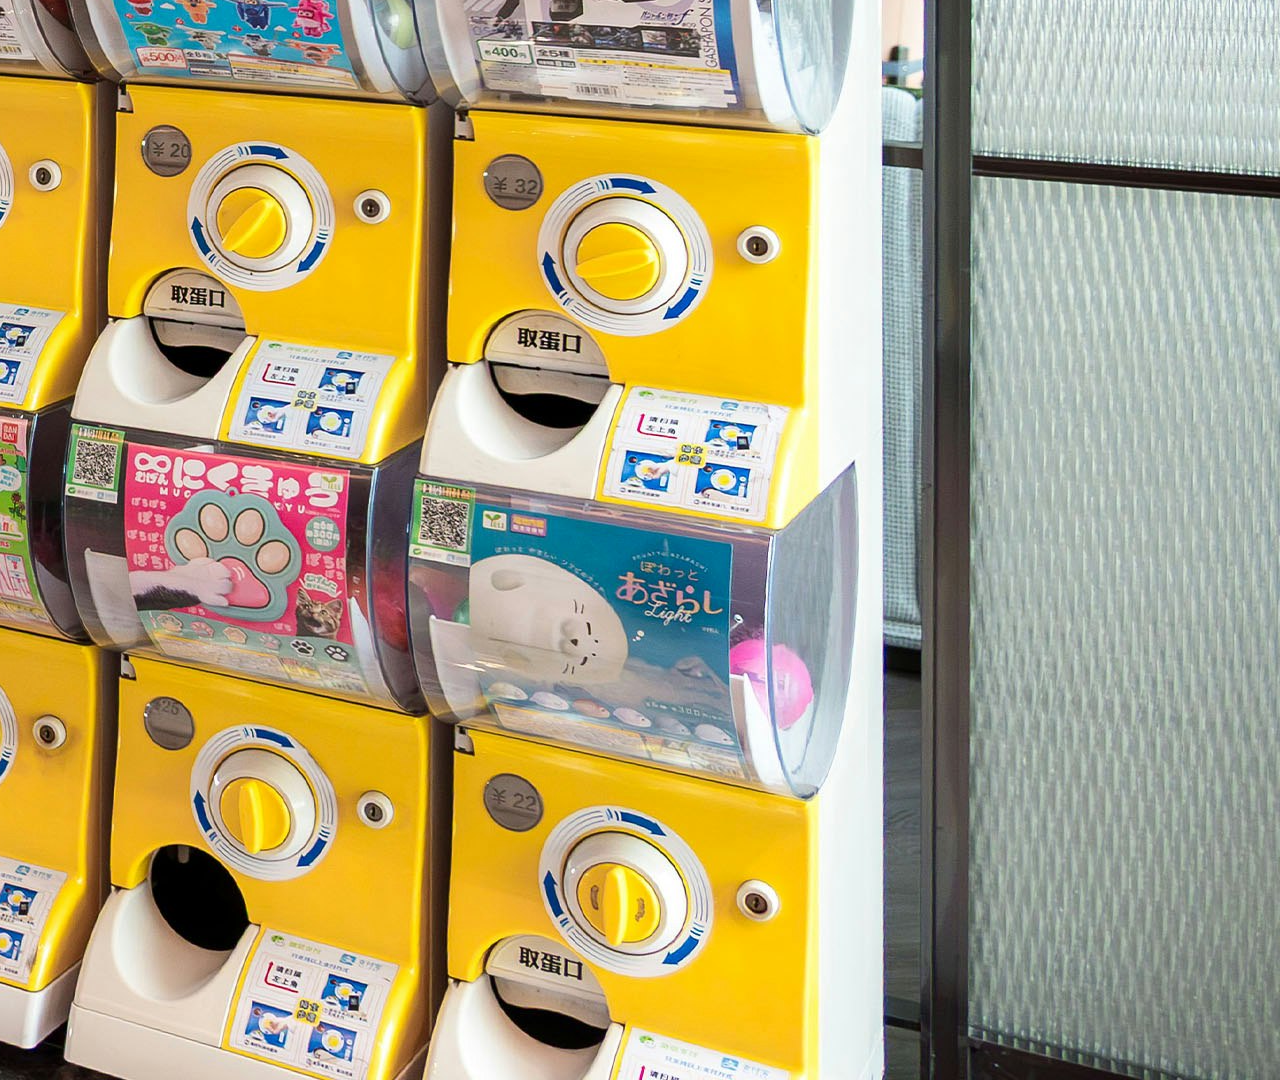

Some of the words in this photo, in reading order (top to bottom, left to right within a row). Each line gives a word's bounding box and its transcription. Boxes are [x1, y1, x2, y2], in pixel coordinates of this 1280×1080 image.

[699, 8, 719, 69] GASHAPON
[537, 48, 571, 58] 全5種
[515, 177, 538, 195] 32
[171, 285, 226, 308] 取蛋口
[517, 327, 583, 354] 取蛋口
[3, 423, 19, 433] BAN
[645, 424, 676, 435] 左上角
[639, 560, 700, 582] ぽわっと
[616, 571, 723, 614] あざらし
[644, 600, 692, 626] Light
[514, 793, 537, 812] 22
[518, 946, 584, 981] 取蛋口
